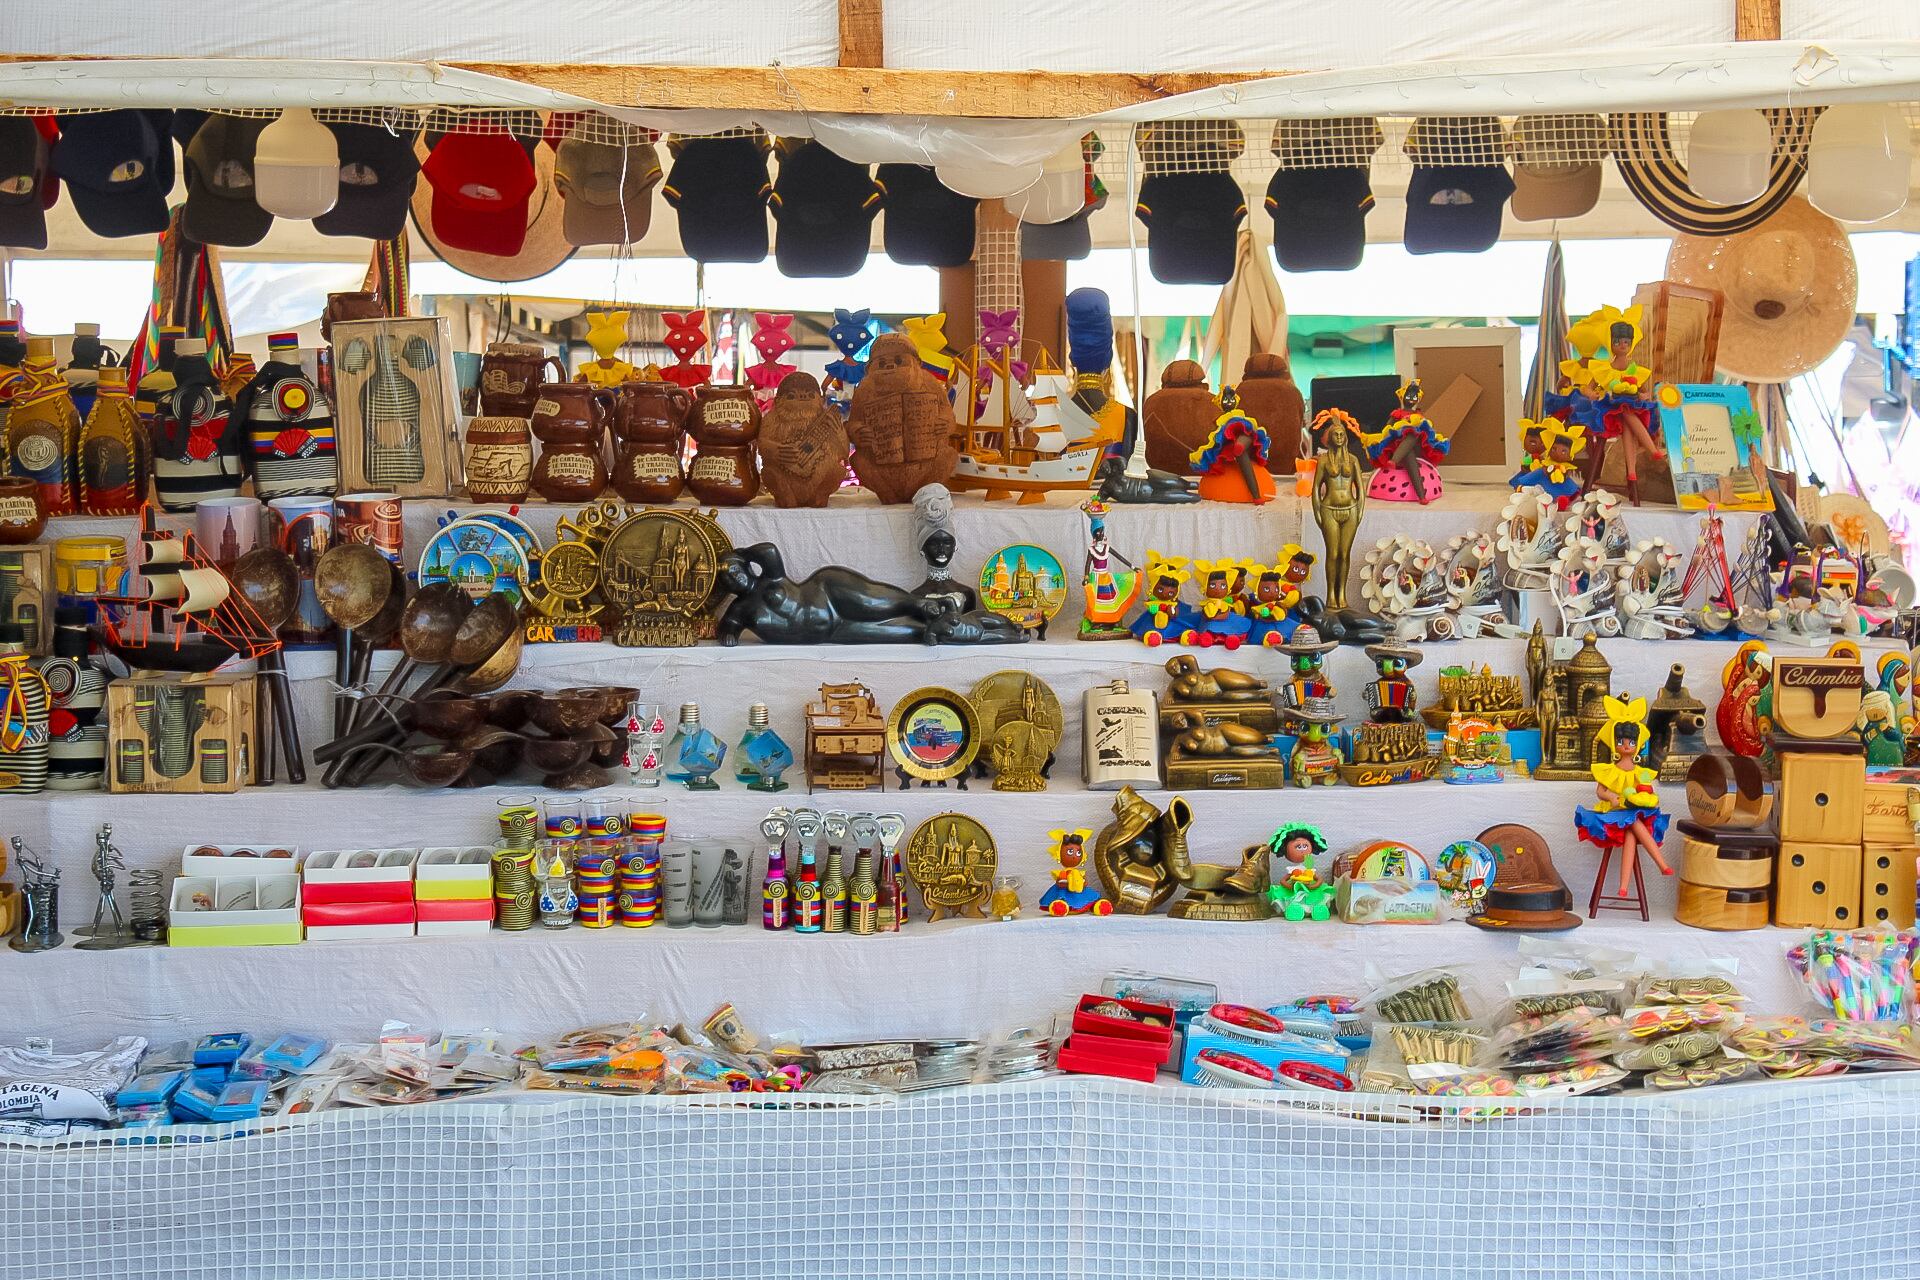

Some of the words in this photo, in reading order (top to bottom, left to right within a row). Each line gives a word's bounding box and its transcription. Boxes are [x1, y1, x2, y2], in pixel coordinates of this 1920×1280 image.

[1684, 391, 1725, 399] CARTAGENA
[706, 401, 739, 412] RECUERDO
[710, 411, 746, 420] CARTAGENA
[1692, 424, 1707, 433] The
[1688, 434, 1718, 445] Unique
[1689, 448, 1726, 456] Collection
[559, 456, 592, 465] CARTAGENA
[645, 456, 676, 464] CARTAGENA
[701, 457, 733, 466] CARTAGENA
[526, 626, 600, 642] CARTAGENA
[617, 629, 694, 647] CARTAGENA
[1784, 666, 1862, 685] Colombia
[1457, 720, 1489, 732] Cartagena
[1212, 773, 1243, 784] Cartagena
[1358, 766, 1423, 787] Colombia
